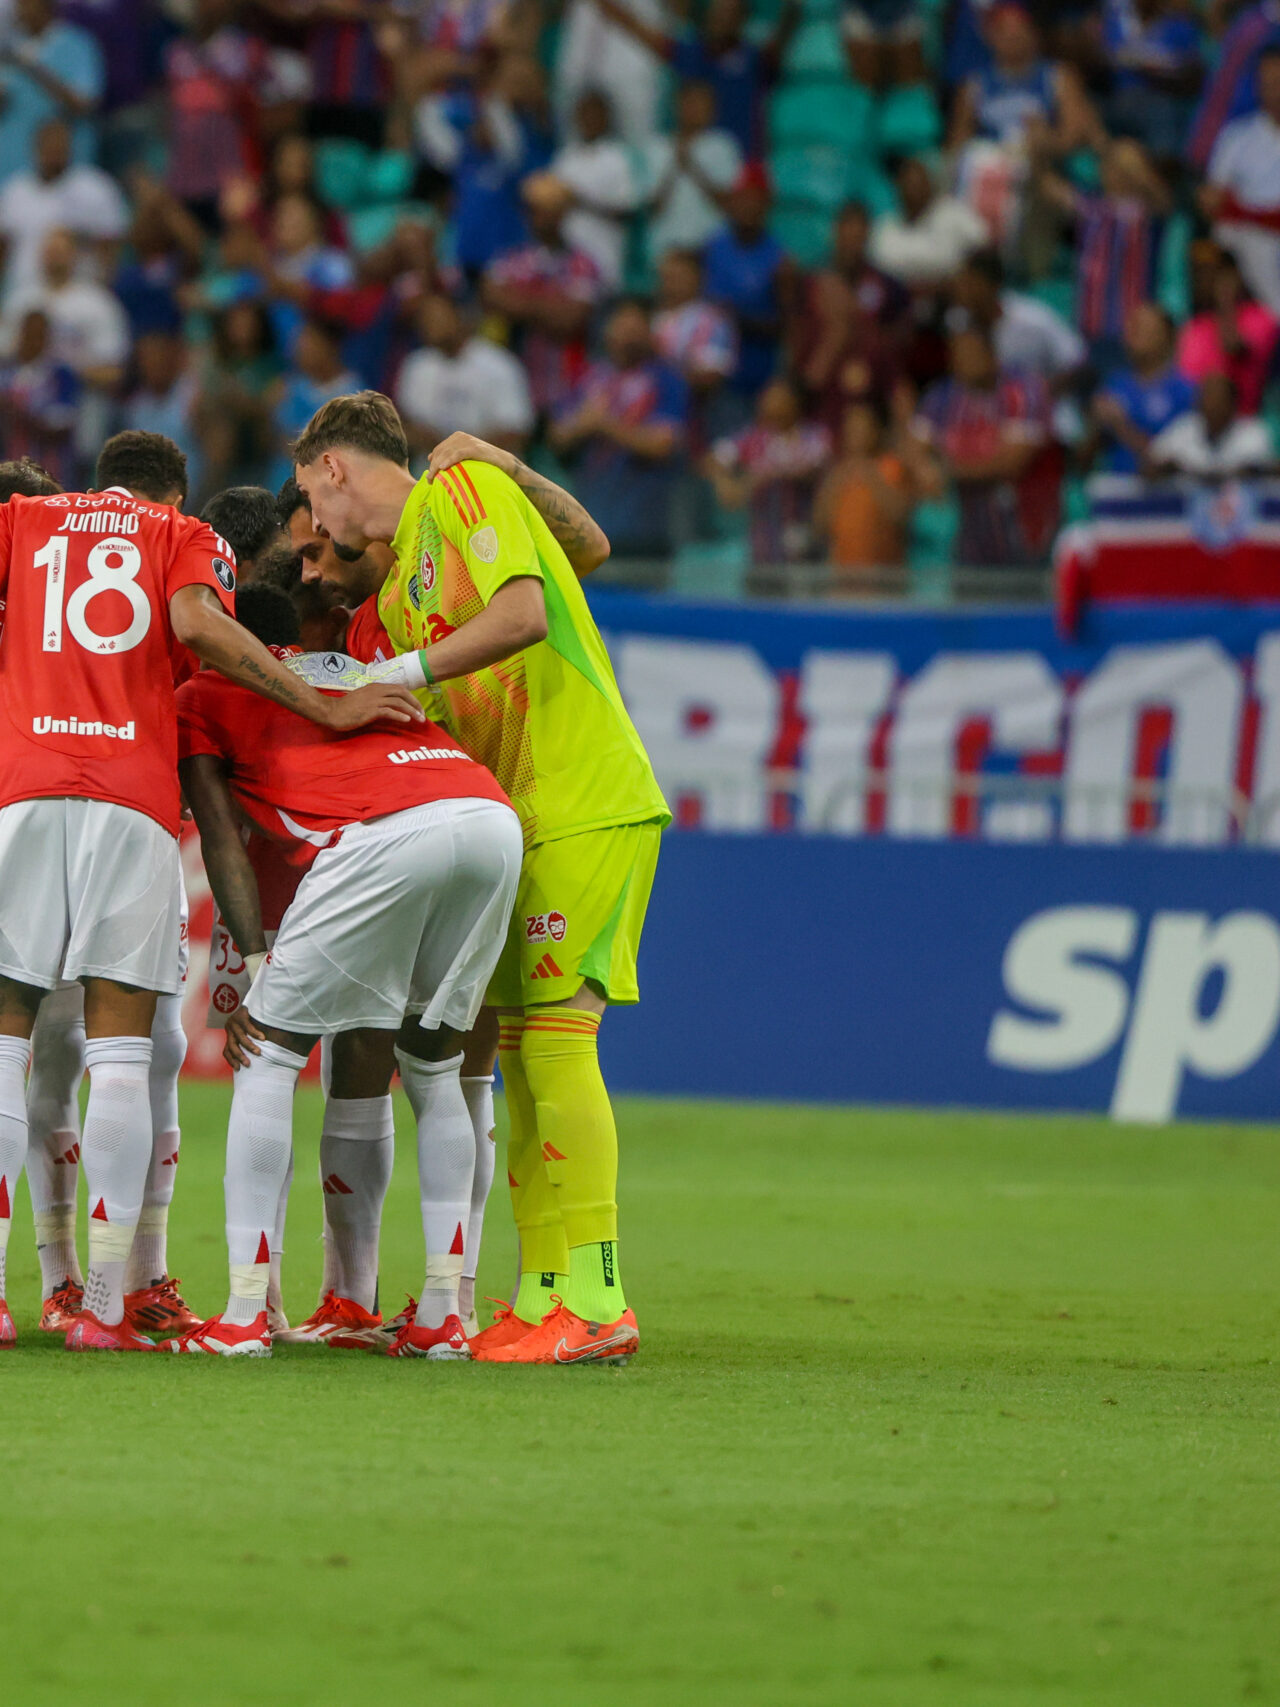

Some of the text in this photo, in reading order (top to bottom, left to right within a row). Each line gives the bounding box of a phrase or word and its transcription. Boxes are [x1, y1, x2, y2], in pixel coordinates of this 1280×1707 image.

[57, 511, 139, 535] JUNINHO
[33, 535, 152, 655] 18
[32, 716, 136, 740] Unimed
[387, 746, 474, 764] Unime
[526, 915, 547, 937] Zé
